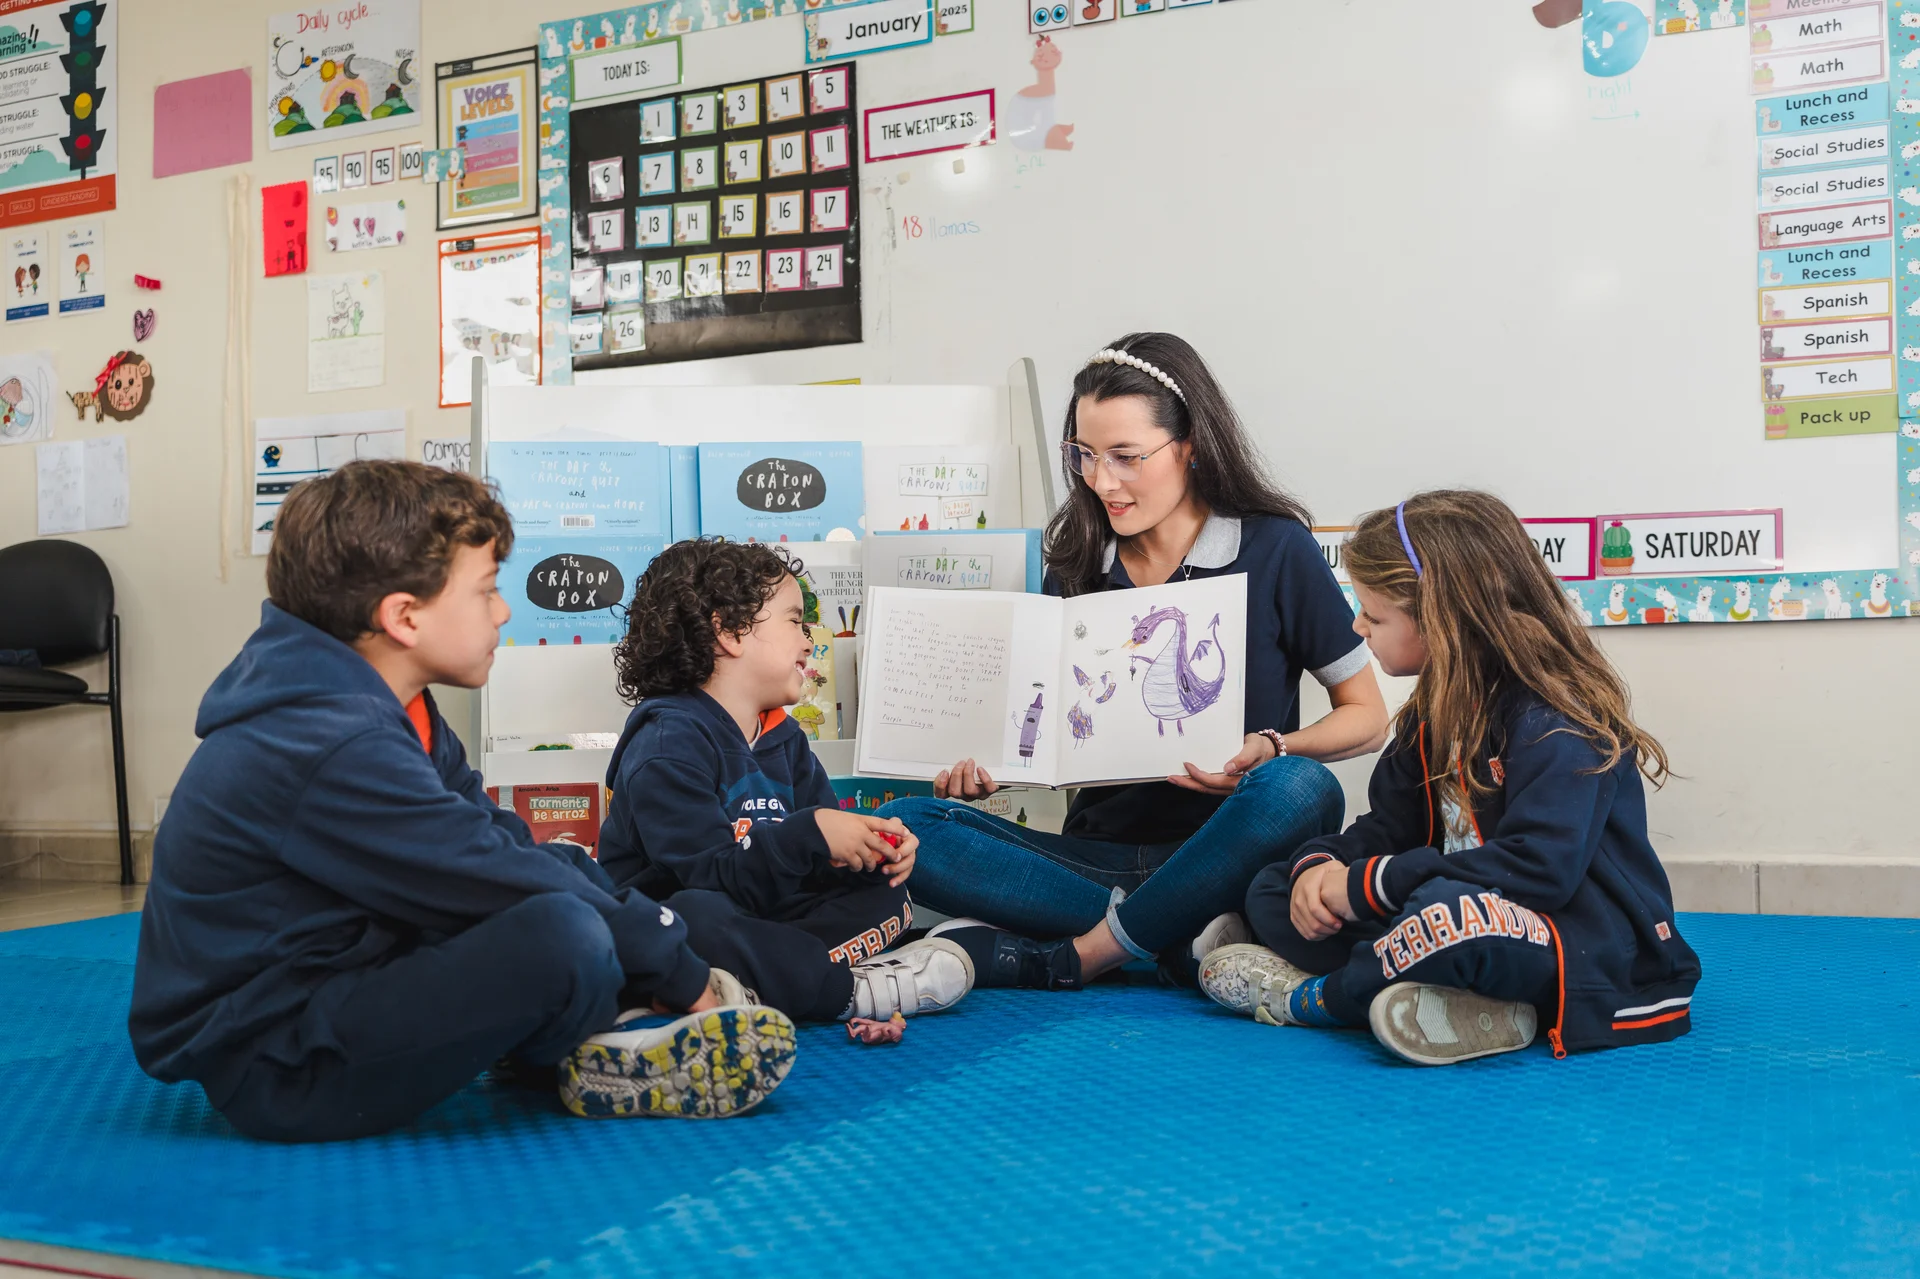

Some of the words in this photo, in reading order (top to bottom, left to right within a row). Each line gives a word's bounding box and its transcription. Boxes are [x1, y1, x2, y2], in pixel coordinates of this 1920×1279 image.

[297, 9, 330, 35] Daily
[337, 2, 369, 30] cycle
[941, 5, 968, 17] 2025
[845, 15, 922, 40] January
[1798, 19, 1842, 37] Math
[603, 63, 633, 82] TODAY
[635, 60, 651, 77] IS:
[1800, 58, 1844, 75] Math
[463, 82, 509, 105] VOICE
[825, 77, 834, 94] 5
[781, 86, 789, 103] 4
[1786, 93, 1832, 111] Lunch
[1837, 88, 1868, 104] and
[460, 94, 514, 121] LEVELS
[738, 95, 746, 112] 3
[696, 104, 703, 121] 2
[1800, 110, 1855, 127] Recess
[882, 123, 902, 140] THE
[904, 114, 958, 138] WEATHER
[781, 142, 793, 160] 10
[827, 135, 834, 153] 11
[1774, 143, 1819, 160] Social
[1826, 138, 1885, 153] Studies
[375, 158, 390, 176] 95
[401, 151, 421, 171] 100
[696, 158, 703, 175] 8
[739, 150, 748, 167] 9
[346, 161, 362, 179] 90
[603, 167, 611, 183] 6
[654, 163, 661, 181] 7
[1774, 181, 1819, 197] Social
[1826, 176, 1885, 192] Studies
[733, 204, 744, 221] 15
[779, 201, 791, 218] 16
[825, 196, 836, 213] 17
[601, 220, 612, 236] 12
[649, 216, 660, 233] 13
[688, 213, 698, 230] 14
[902, 216, 923, 240] 18
[929, 217, 980, 242] llamas
[1776, 219, 1844, 236] Language
[1851, 215, 1886, 227] Arts
[1788, 249, 1834, 263] Lunch
[1839, 245, 1870, 259] and
[736, 260, 751, 278] 22
[778, 256, 793, 274] 23
[817, 254, 832, 272] 24
[656, 270, 672, 287] 20
[1802, 267, 1856, 280] Recess
[1803, 292, 1868, 313] Spanish
[620, 320, 635, 337] 26
[1804, 329, 1869, 349] Spanish
[1815, 369, 1858, 384] Tech
[1801, 410, 1843, 424] Pack
[1849, 409, 1871, 424] up
[541, 461, 559, 471] THE
[566, 460, 591, 474] DAY
[768, 460, 787, 472] The
[909, 467, 926, 476] THE
[934, 466, 956, 479] DAY
[965, 467, 978, 479] the
[531, 471, 585, 488] CRAYONS
[591, 476, 621, 491] QUIT
[746, 473, 813, 489] CRAYON
[900, 477, 951, 491] CRAYONS
[958, 480, 986, 493] QUIT
[569, 490, 586, 498] and
[765, 491, 802, 508] BOX
[1532, 537, 1566, 563] AY
[1645, 529, 1761, 559] SATURDAY
[561, 556, 581, 568] The
[909, 558, 927, 568] THE
[936, 557, 958, 572] DAY
[968, 557, 982, 571] the
[537, 570, 609, 587] CRAYON
[900, 569, 952, 585] CRAYONS
[961, 572, 989, 588] QUIT
[557, 590, 597, 608] BOX
[948, 694, 968, 704] LOSE
[530, 797, 589, 809] Tormenta
[533, 810, 548, 821] De
[552, 810, 586, 820] arroz
[1373, 892, 1551, 980] TERRANOVA
